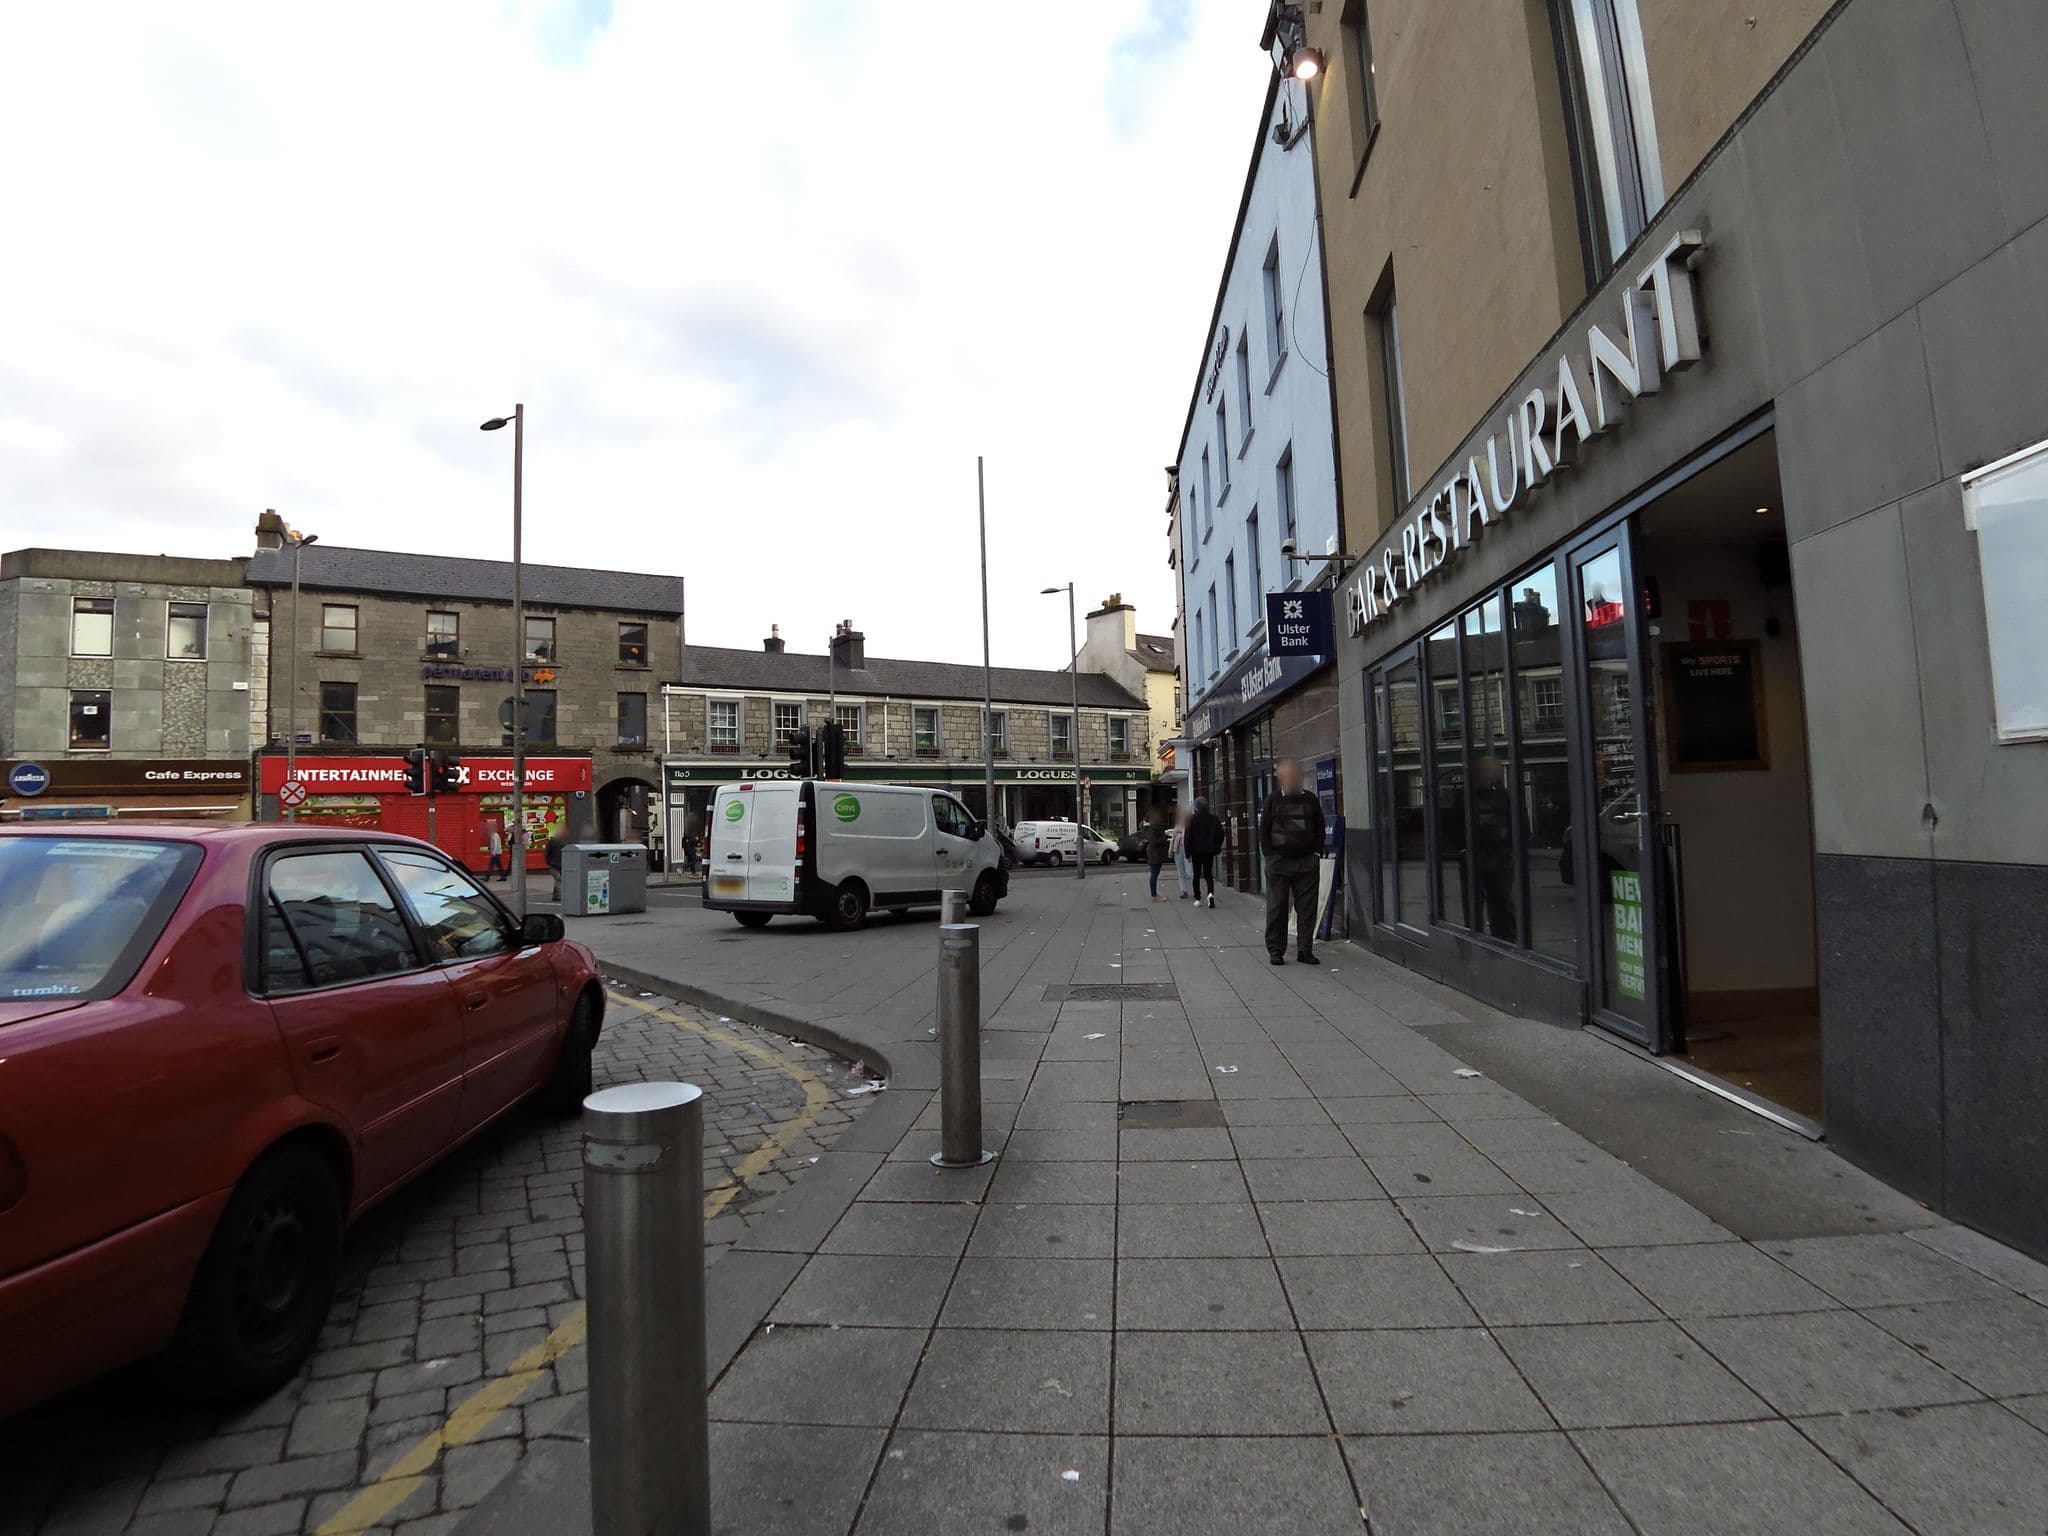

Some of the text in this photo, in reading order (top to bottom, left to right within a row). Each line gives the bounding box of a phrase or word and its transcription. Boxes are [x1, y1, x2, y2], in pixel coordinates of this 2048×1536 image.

[1347, 565, 1378, 638] BAR
[1384, 547, 1399, 607] &
[1402, 230, 1684, 592] RESTAURANT
[1278, 624, 1311, 635] Ulster
[1281, 636, 1309, 647] Bank
[1698, 655, 1741, 665] SPORTS
[1690, 666, 1733, 677] LIVE HERE
[1247, 656, 1283, 700] Ulster Bank
[145, 770, 242, 781] Cafe Express
[287, 769, 414, 781] NTERTAINME
[478, 770, 555, 781] EXCHNGE
[740, 768, 818, 780] LOG
[1016, 770, 1077, 780] LOGUES
[1615, 903, 1643, 934] BA
[1616, 933, 1643, 958] MEN
